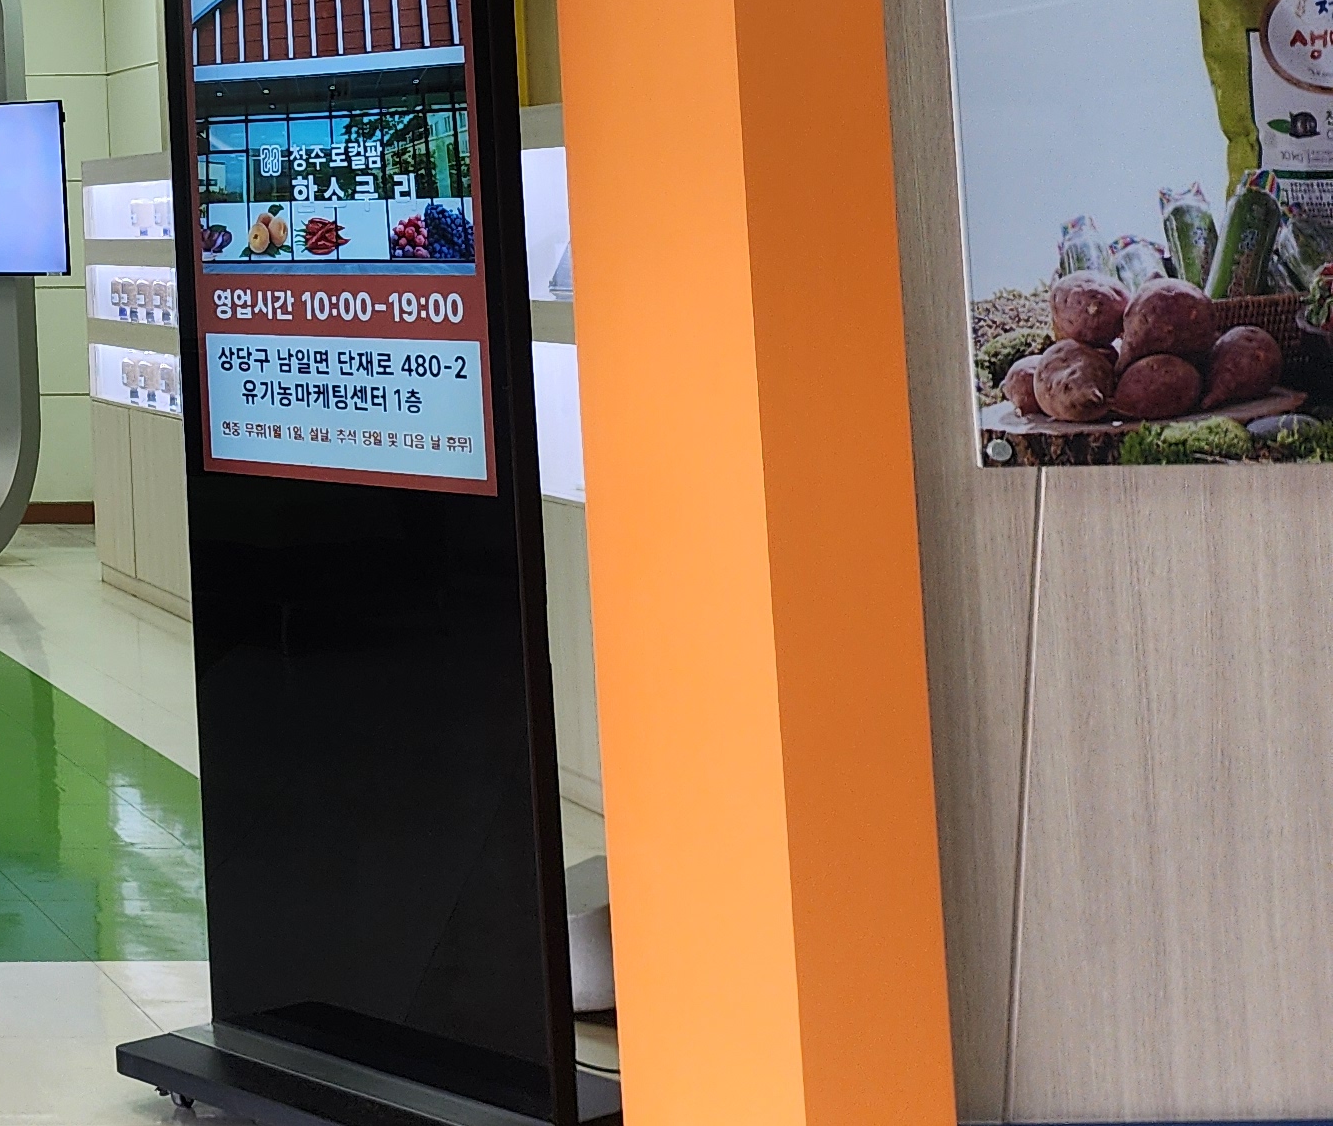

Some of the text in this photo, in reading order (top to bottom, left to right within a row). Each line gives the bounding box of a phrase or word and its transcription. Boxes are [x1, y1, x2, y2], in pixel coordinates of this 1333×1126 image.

[1289, 28, 1333, 61] 생
[213, 288, 464, 323] 영업시간 10:00-19:00
[218, 346, 468, 380] 상당구 남일면 단재로 480-2
[241, 379, 423, 414] 유기농마케팅센터 1층
[222, 420, 241, 437] 연중
[336, 428, 358, 445] 추석
[362, 431, 383, 447] 당일
[387, 432, 399, 448] 및
[403, 433, 425, 450] 다음
[430, 434, 441, 451] 날
